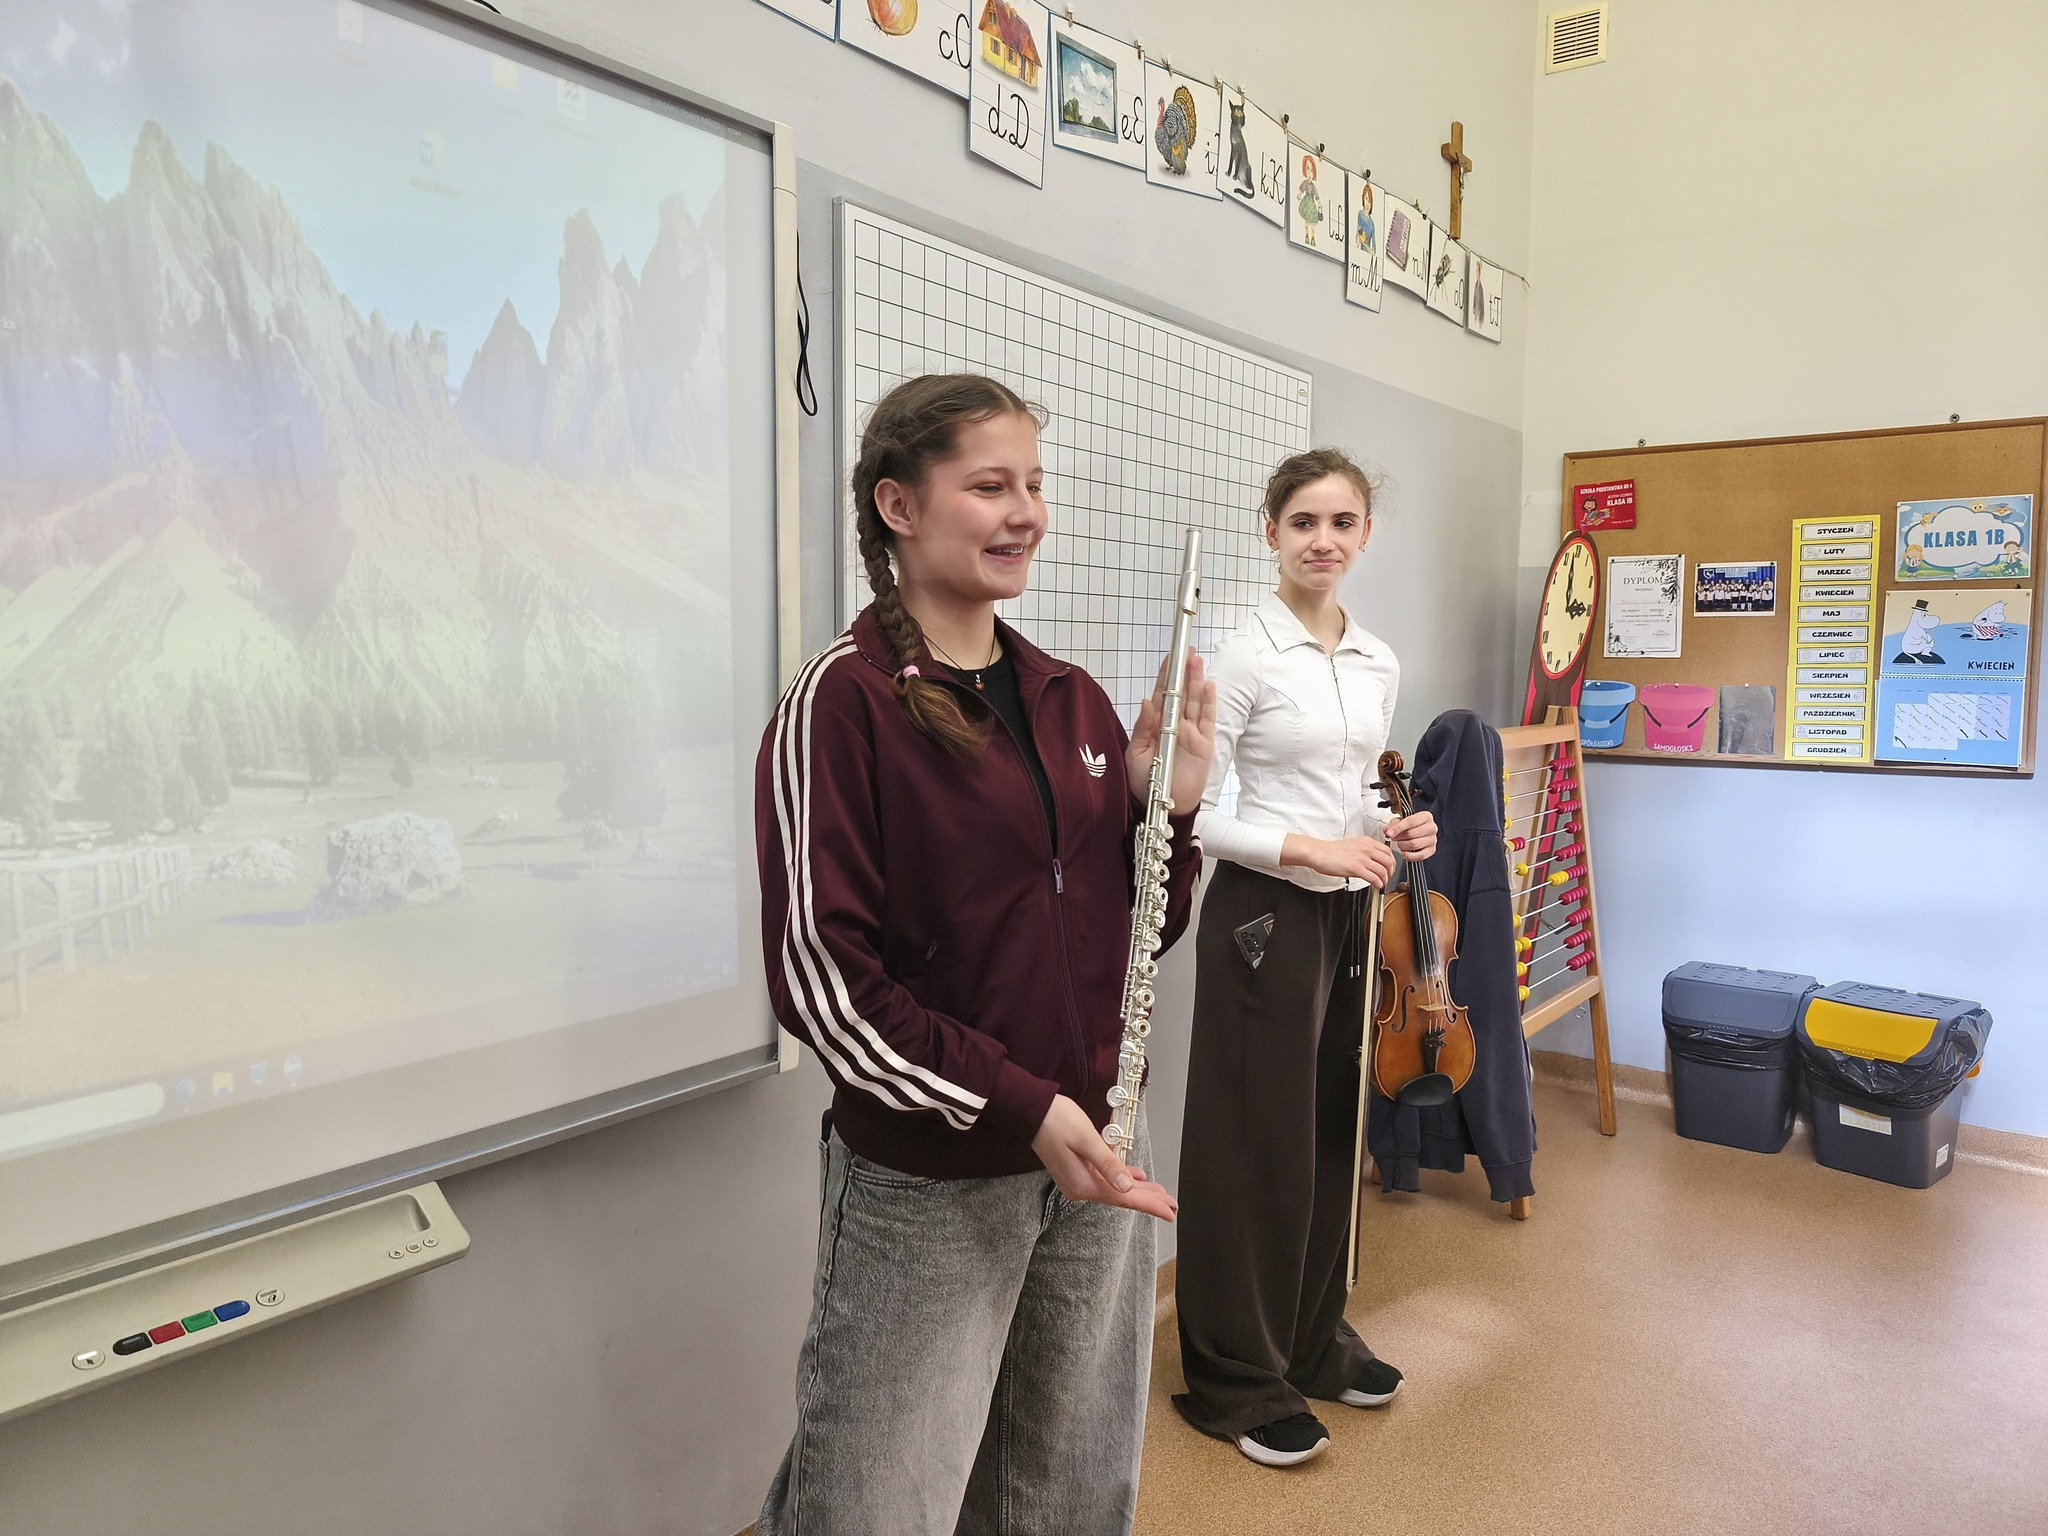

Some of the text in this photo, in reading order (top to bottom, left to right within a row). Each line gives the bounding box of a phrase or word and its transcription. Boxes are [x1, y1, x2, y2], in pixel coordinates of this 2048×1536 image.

[988, 84, 1029, 149] dD
[1606, 498, 1626, 506] KLASA
[1817, 526, 1854, 534] STYCZEŃ
[1924, 529, 2005, 548] KLASA 1B
[1623, 577, 1663, 585] DYPLOM
[1968, 660, 2015, 670] KWIECIEŃ
